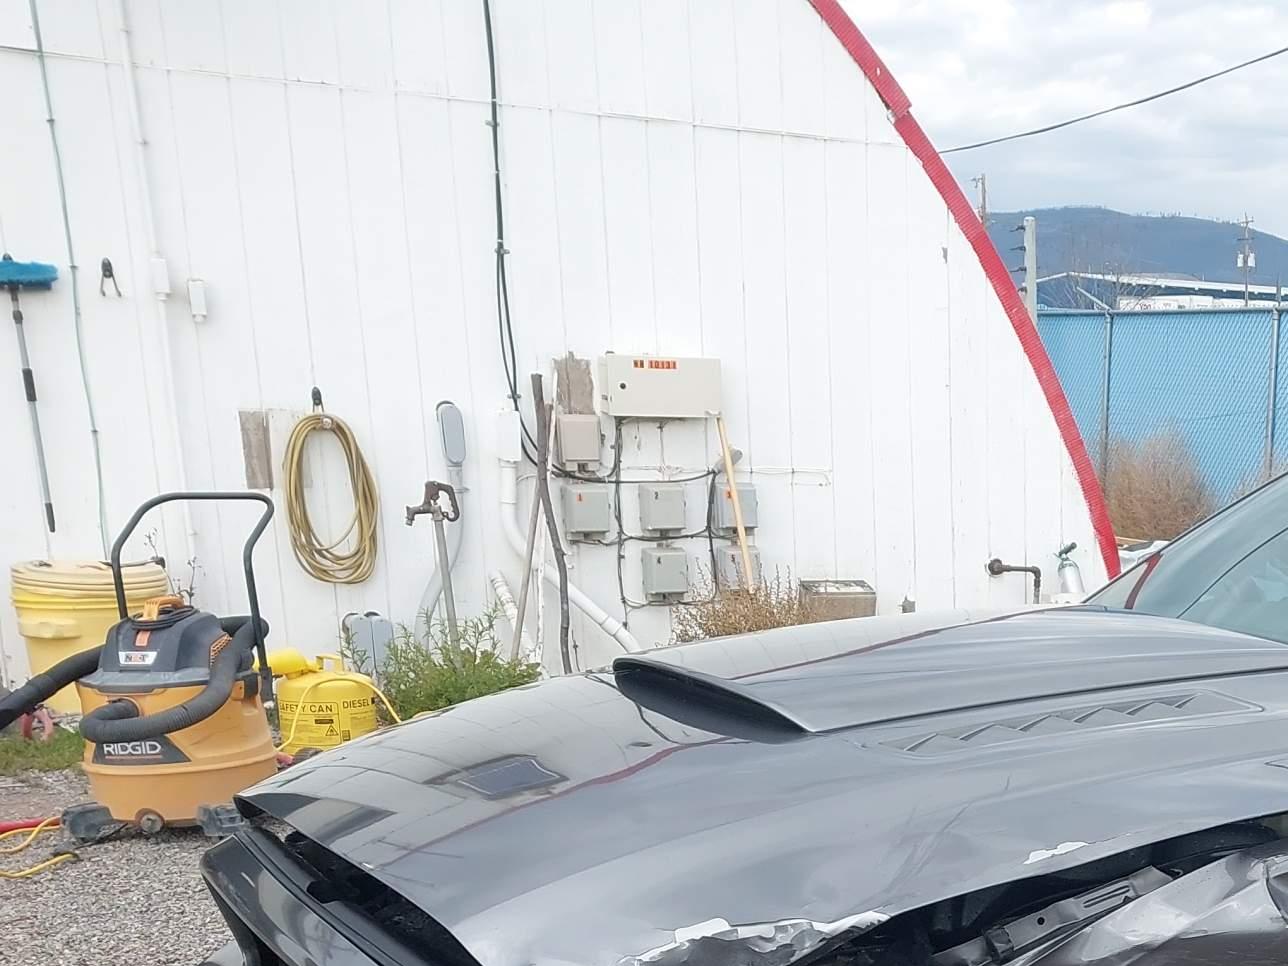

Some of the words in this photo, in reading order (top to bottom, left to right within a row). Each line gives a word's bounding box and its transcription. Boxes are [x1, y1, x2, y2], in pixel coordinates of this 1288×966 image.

[280, 703, 306, 712] AFETY
[309, 704, 333, 713] CAN
[342, 699, 370, 709] DIESEL
[103, 741, 161, 755] RIDGID
